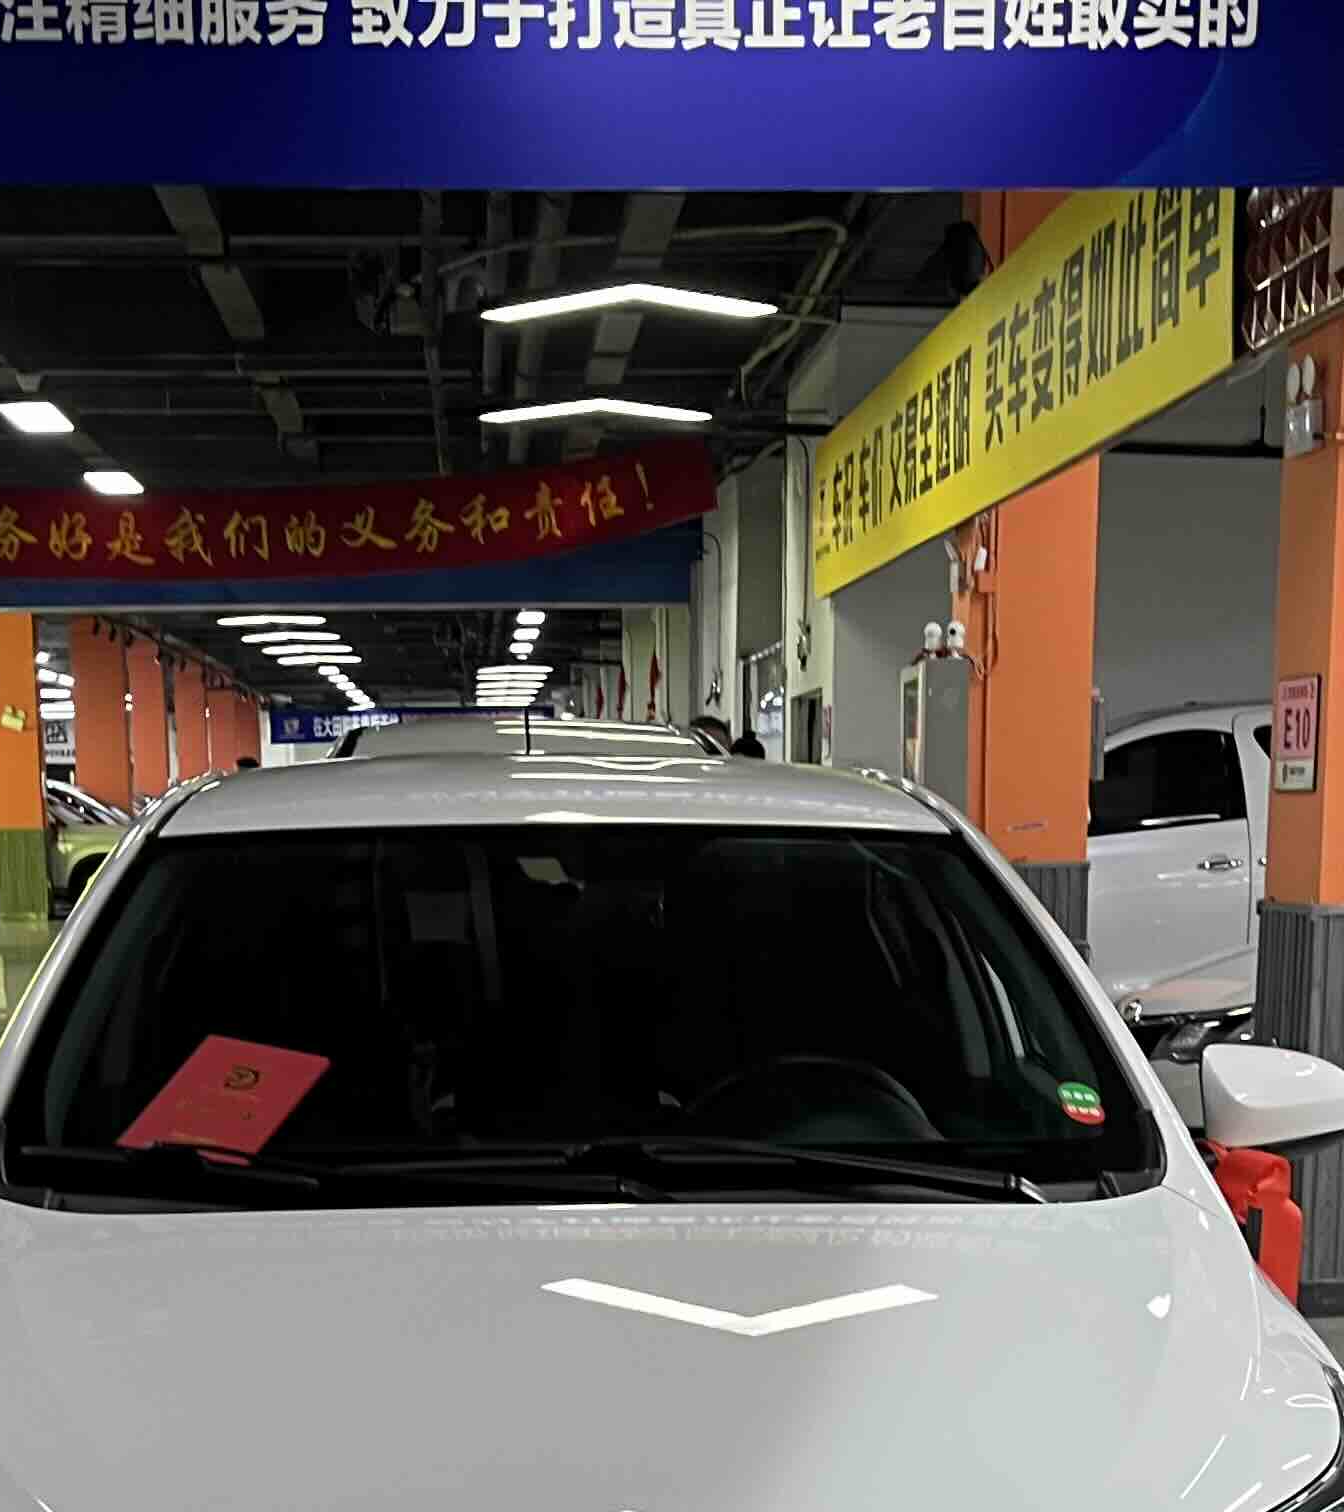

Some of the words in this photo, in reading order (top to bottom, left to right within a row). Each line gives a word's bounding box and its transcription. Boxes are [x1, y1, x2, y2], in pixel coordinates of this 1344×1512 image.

[859, 431, 884, 537] 车价
[889, 343, 972, 516] 交易全透明
[984, 187, 1221, 454] 买车变得如此简单
[1283, 707, 1312, 750] E10
